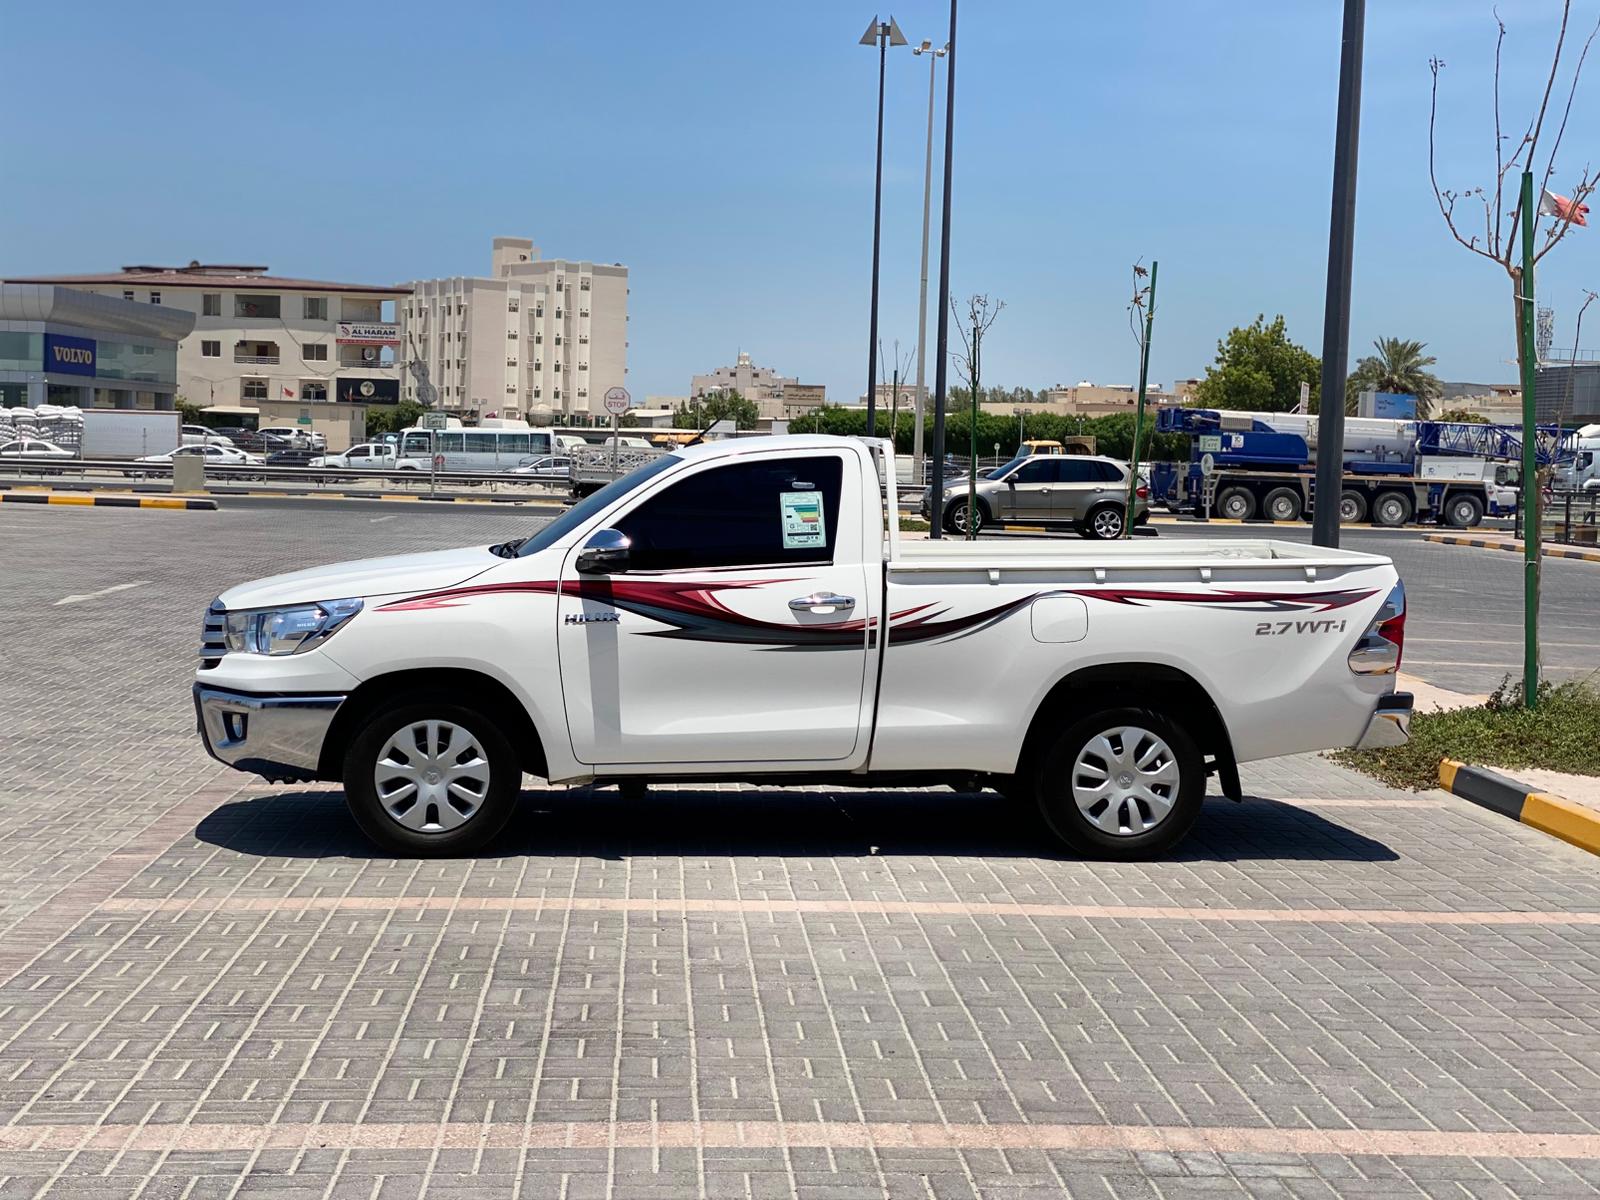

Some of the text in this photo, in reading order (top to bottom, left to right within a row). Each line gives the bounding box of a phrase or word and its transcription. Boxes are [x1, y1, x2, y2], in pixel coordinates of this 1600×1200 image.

[53, 346, 92, 364] VOLVO
[564, 613, 620, 625] HILUX
[1255, 622, 1293, 636] 2.7
